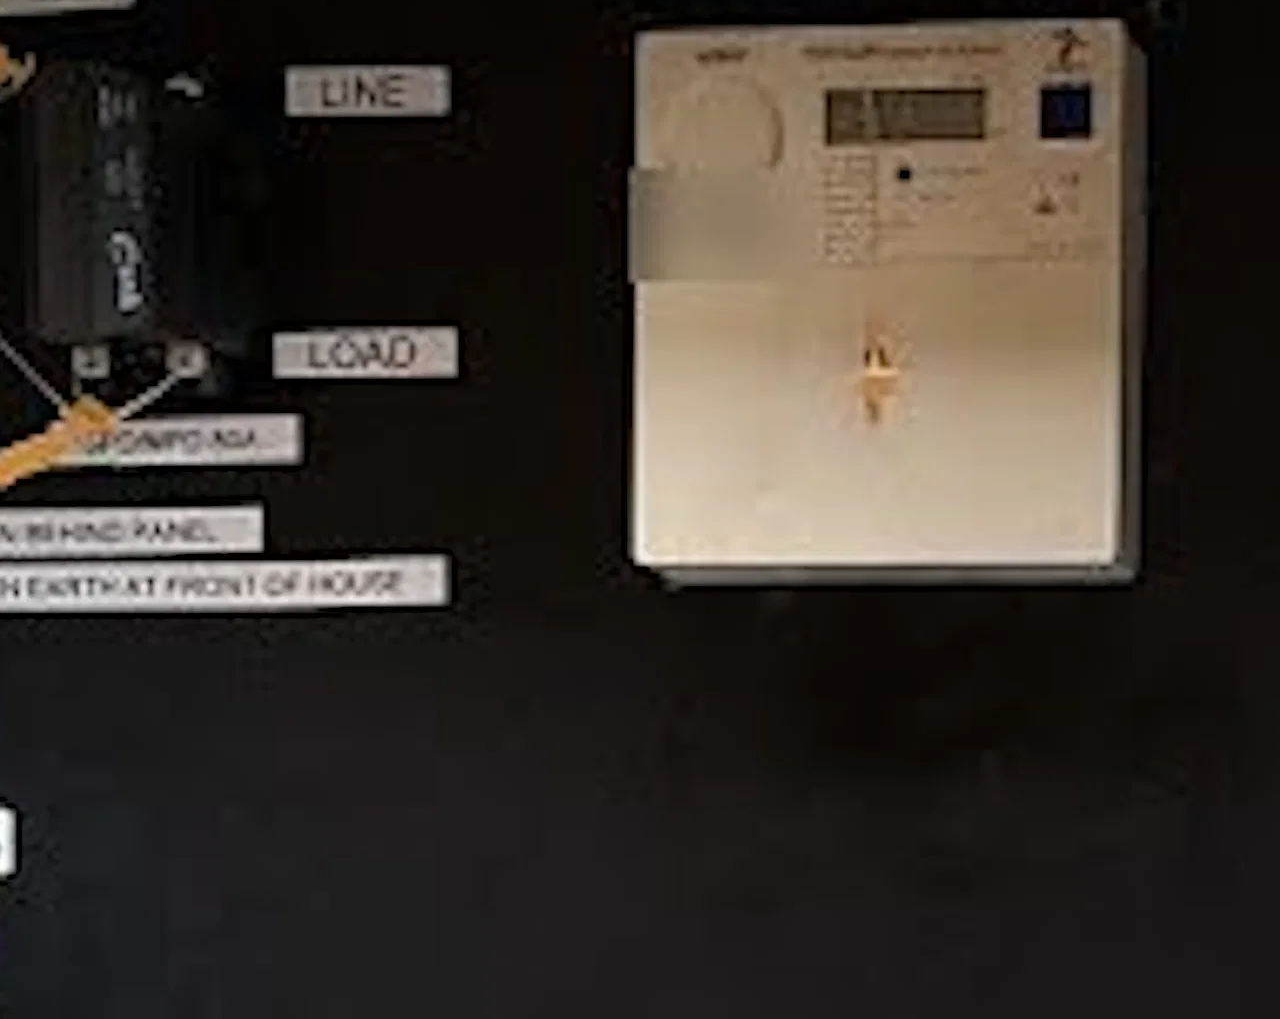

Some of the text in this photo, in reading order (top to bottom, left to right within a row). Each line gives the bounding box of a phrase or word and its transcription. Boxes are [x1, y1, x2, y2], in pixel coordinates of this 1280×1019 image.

[320, 76, 406, 108] LINE
[308, 337, 416, 370] LOAD
[27, 577, 116, 598] EARTH
[120, 576, 155, 597] AT
[168, 573, 255, 597] FRONT
[265, 572, 298, 596] OF
[308, 570, 404, 596] HOUSE
